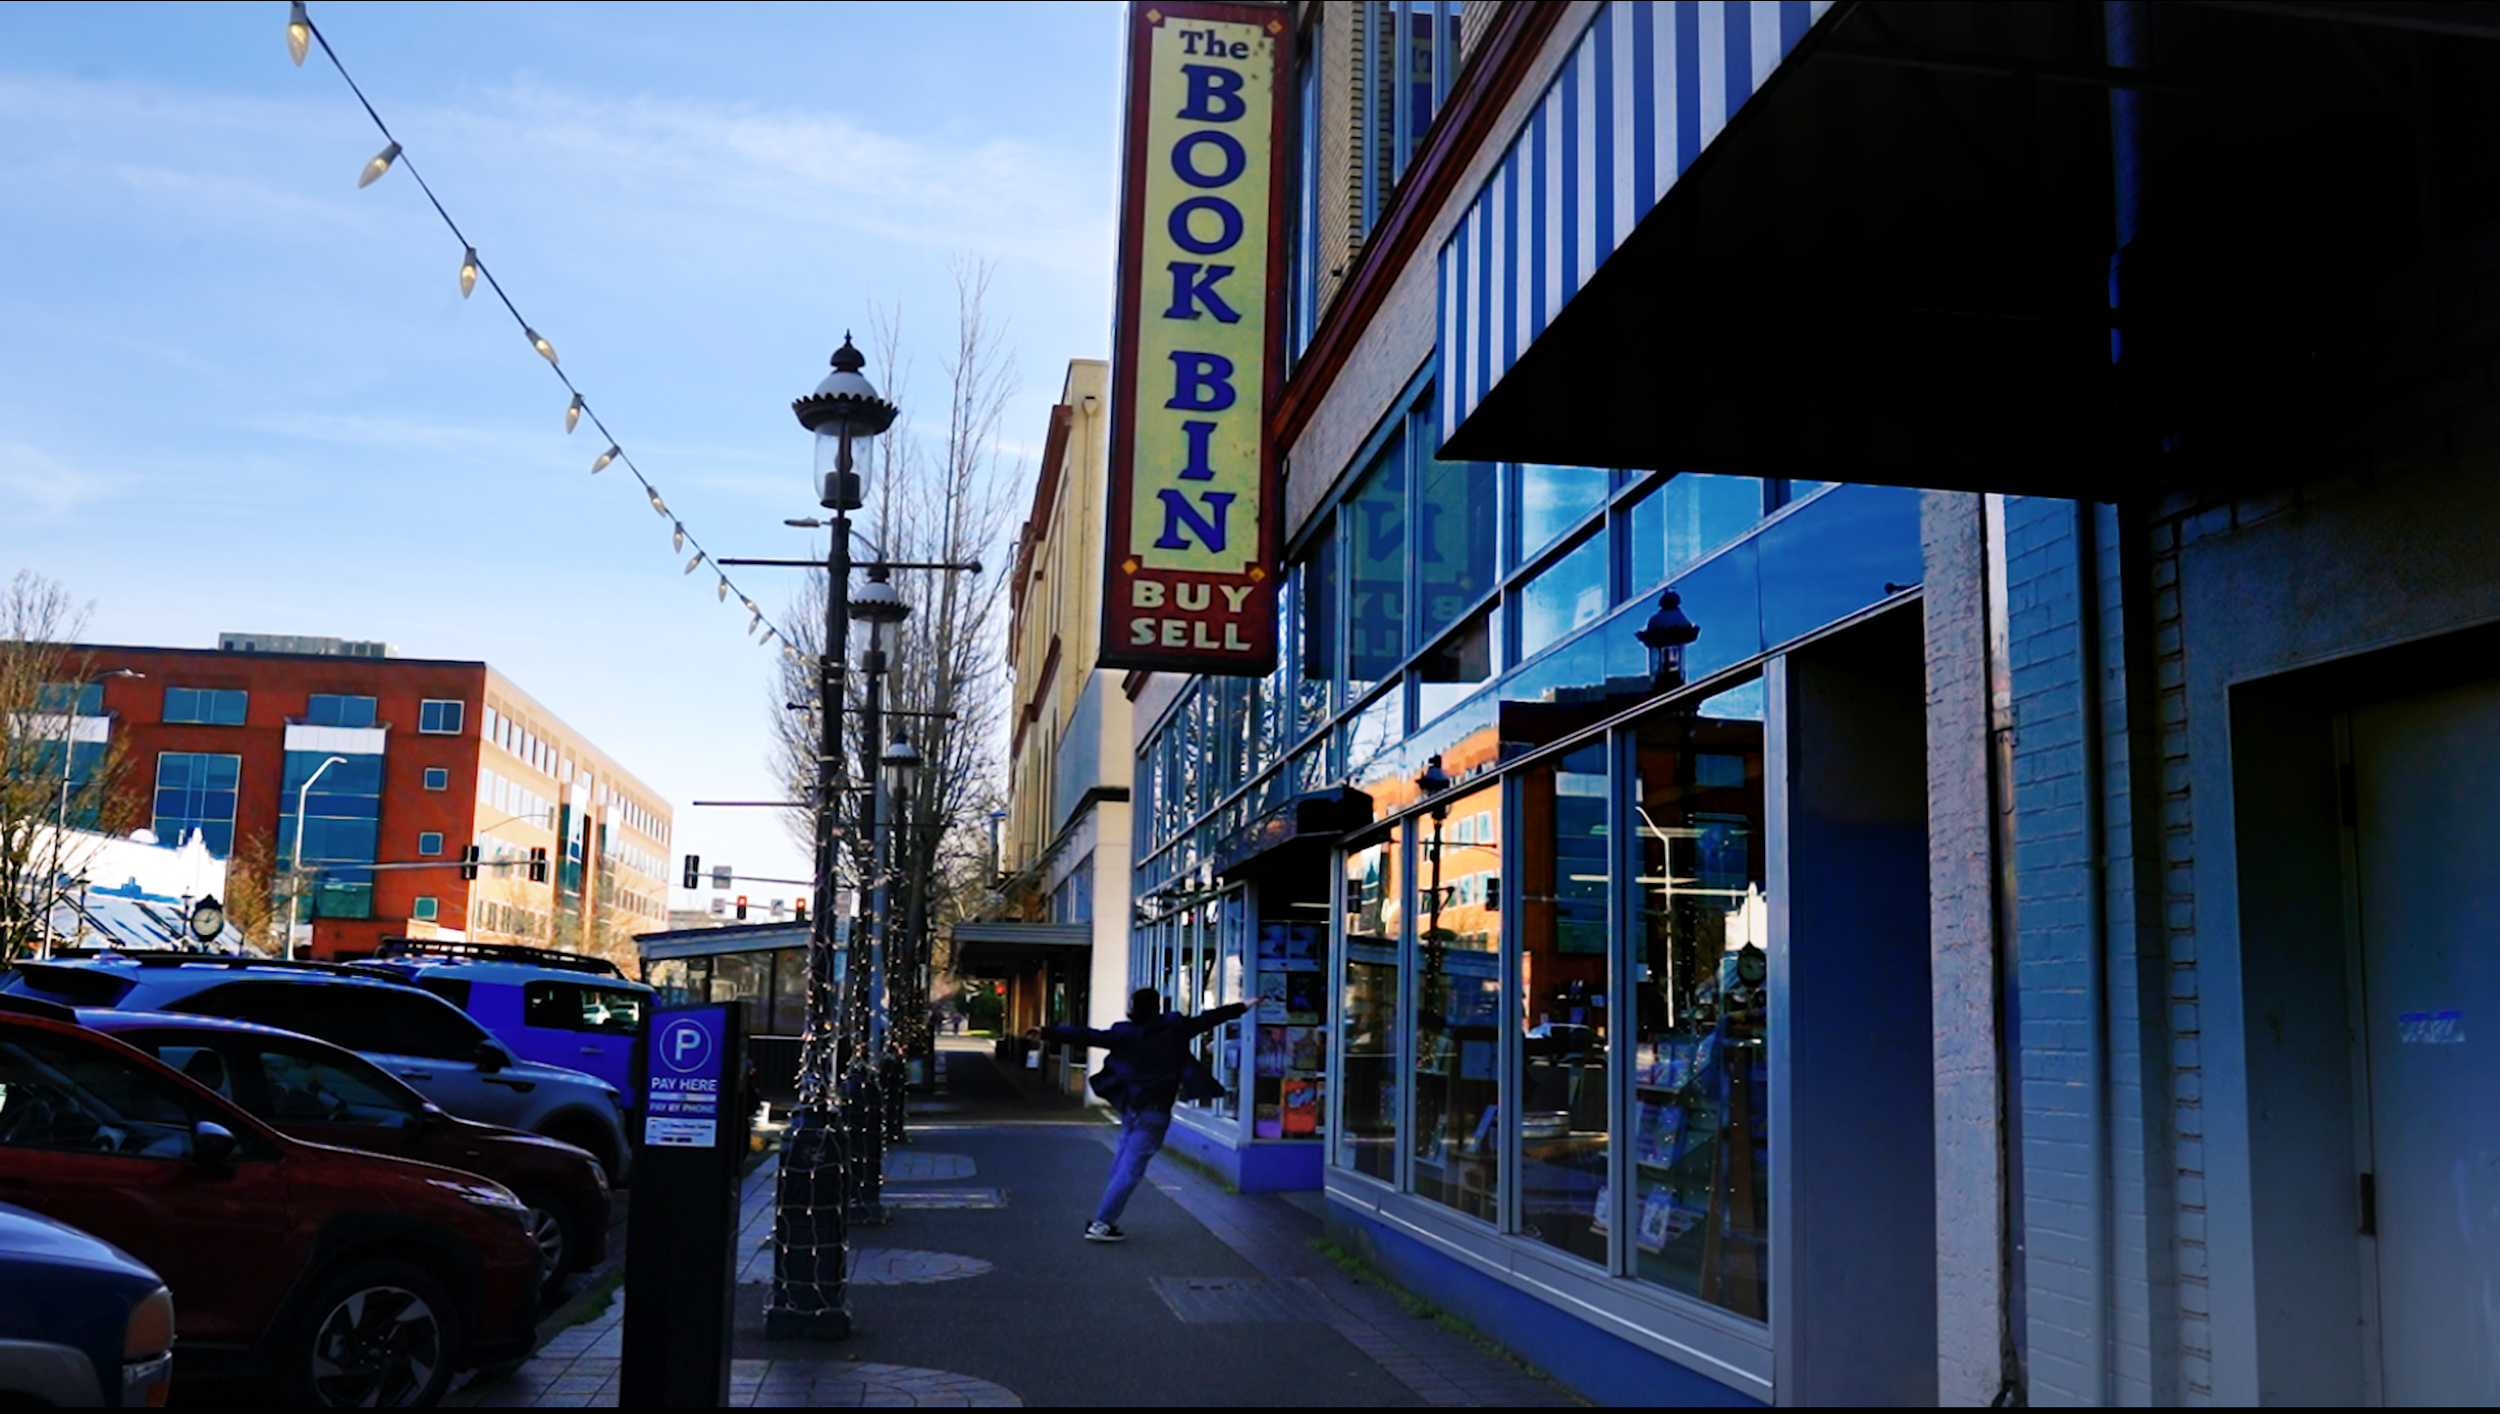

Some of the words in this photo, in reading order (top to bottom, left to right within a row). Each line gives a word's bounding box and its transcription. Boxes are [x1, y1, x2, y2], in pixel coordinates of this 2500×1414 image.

[1179, 29, 1249, 60] The
[1162, 64, 1246, 324] BOOK
[1153, 350, 1237, 553] BIN
[1132, 579, 1254, 613] BUY
[1130, 617, 1252, 651] SELL
[675, 1028, 701, 1061] P
[651, 1077, 677, 1090] PAY
[680, 1079, 718, 1092] HERE
